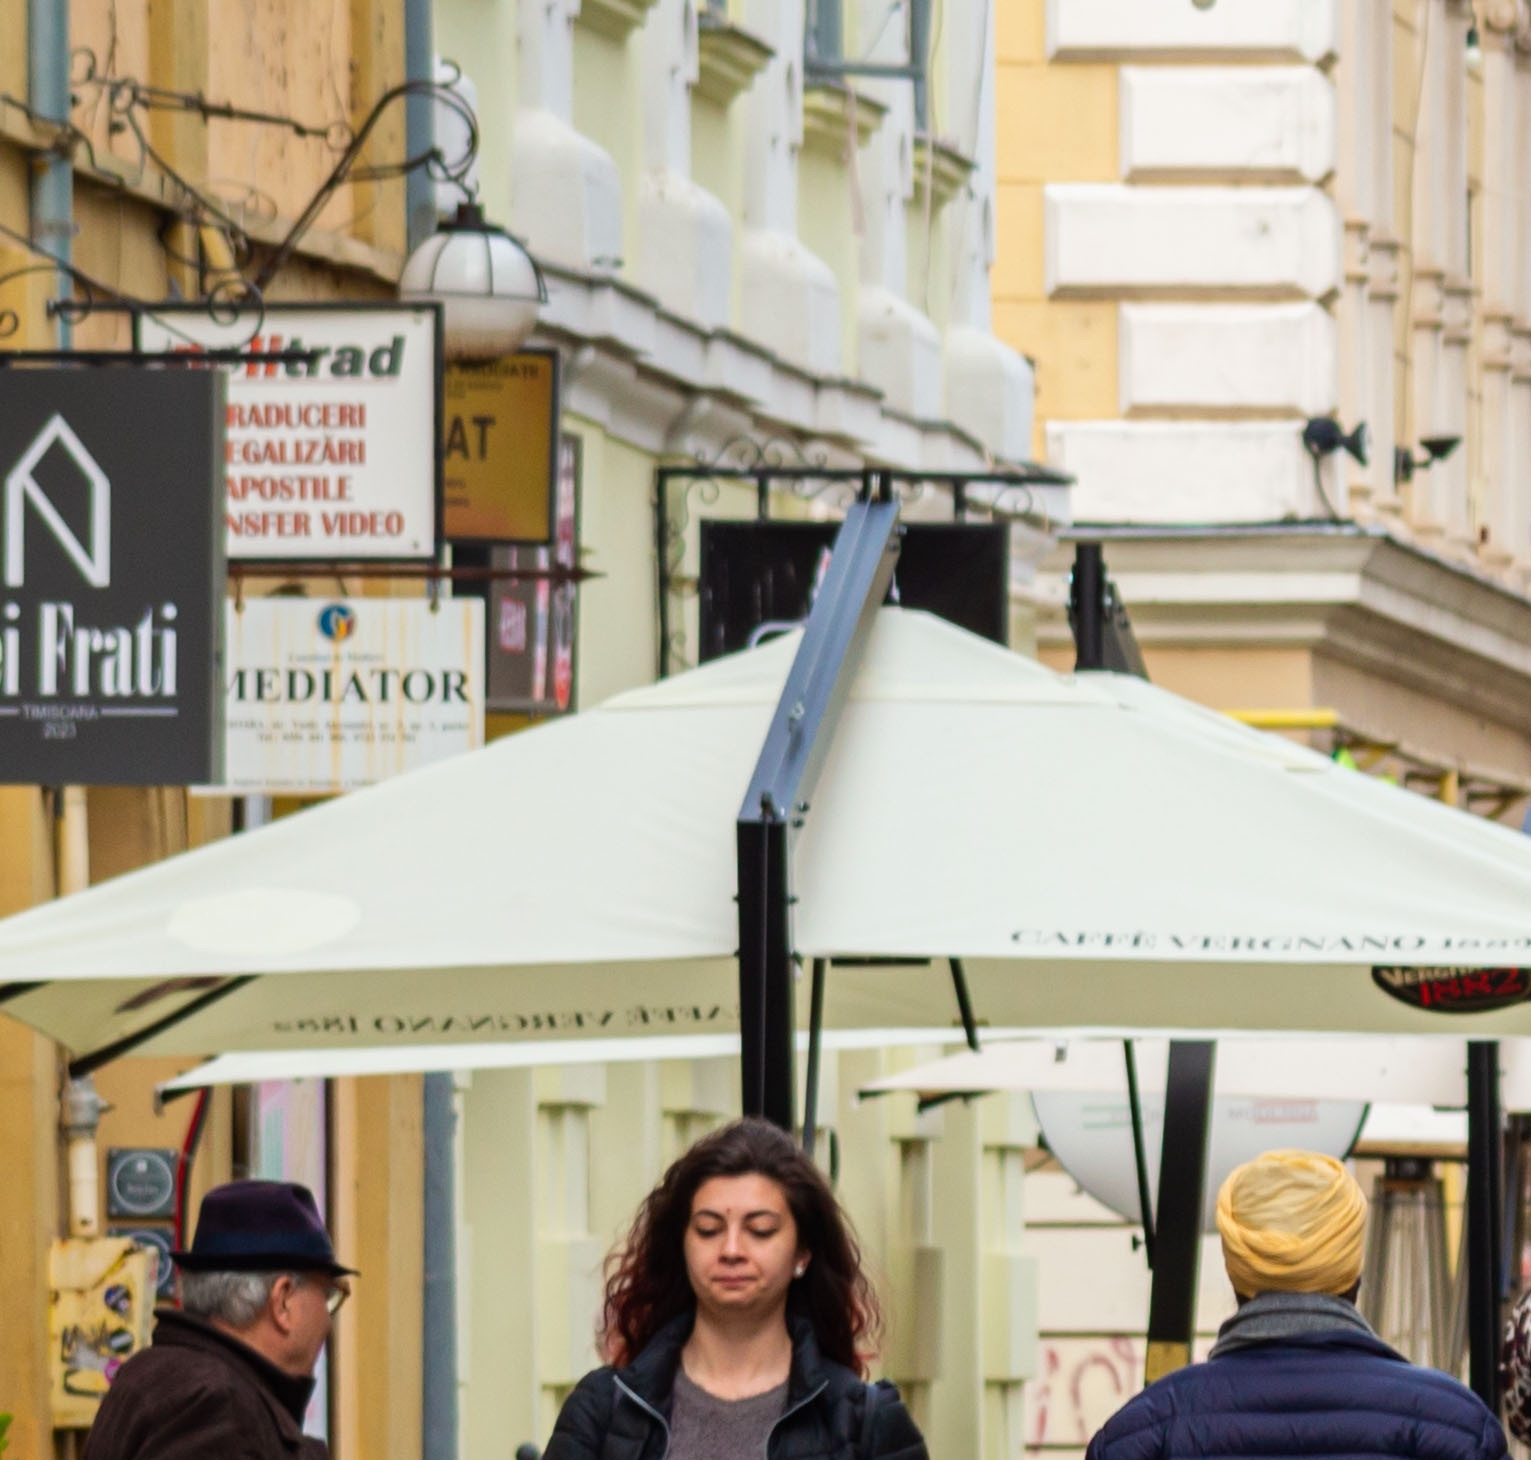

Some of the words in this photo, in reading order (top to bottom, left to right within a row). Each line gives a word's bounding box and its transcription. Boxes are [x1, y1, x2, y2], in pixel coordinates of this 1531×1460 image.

[226, 402, 366, 428] RADUCERI
[226, 435, 366, 464] EGALIZĂRI
[444, 416, 496, 461] AT
[321, 511, 405, 537] VIDEO
[41, 602, 178, 697] Frati
